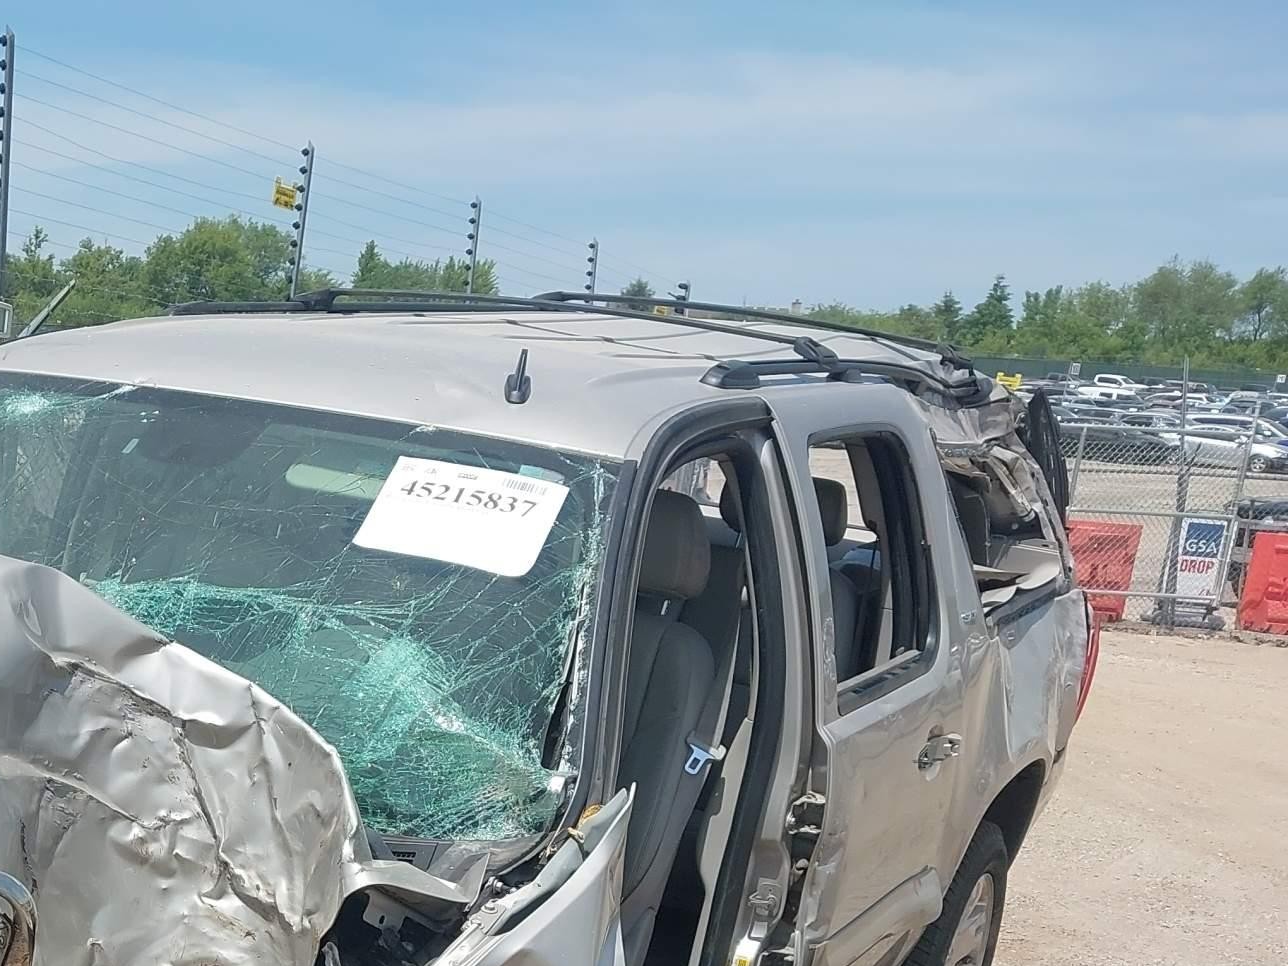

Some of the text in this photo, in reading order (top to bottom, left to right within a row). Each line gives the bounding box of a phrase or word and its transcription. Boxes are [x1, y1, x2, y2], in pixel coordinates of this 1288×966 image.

[400, 480, 538, 518] 45215837
[1185, 540, 1218, 554] GSA
[1179, 559, 1215, 575] DROP
